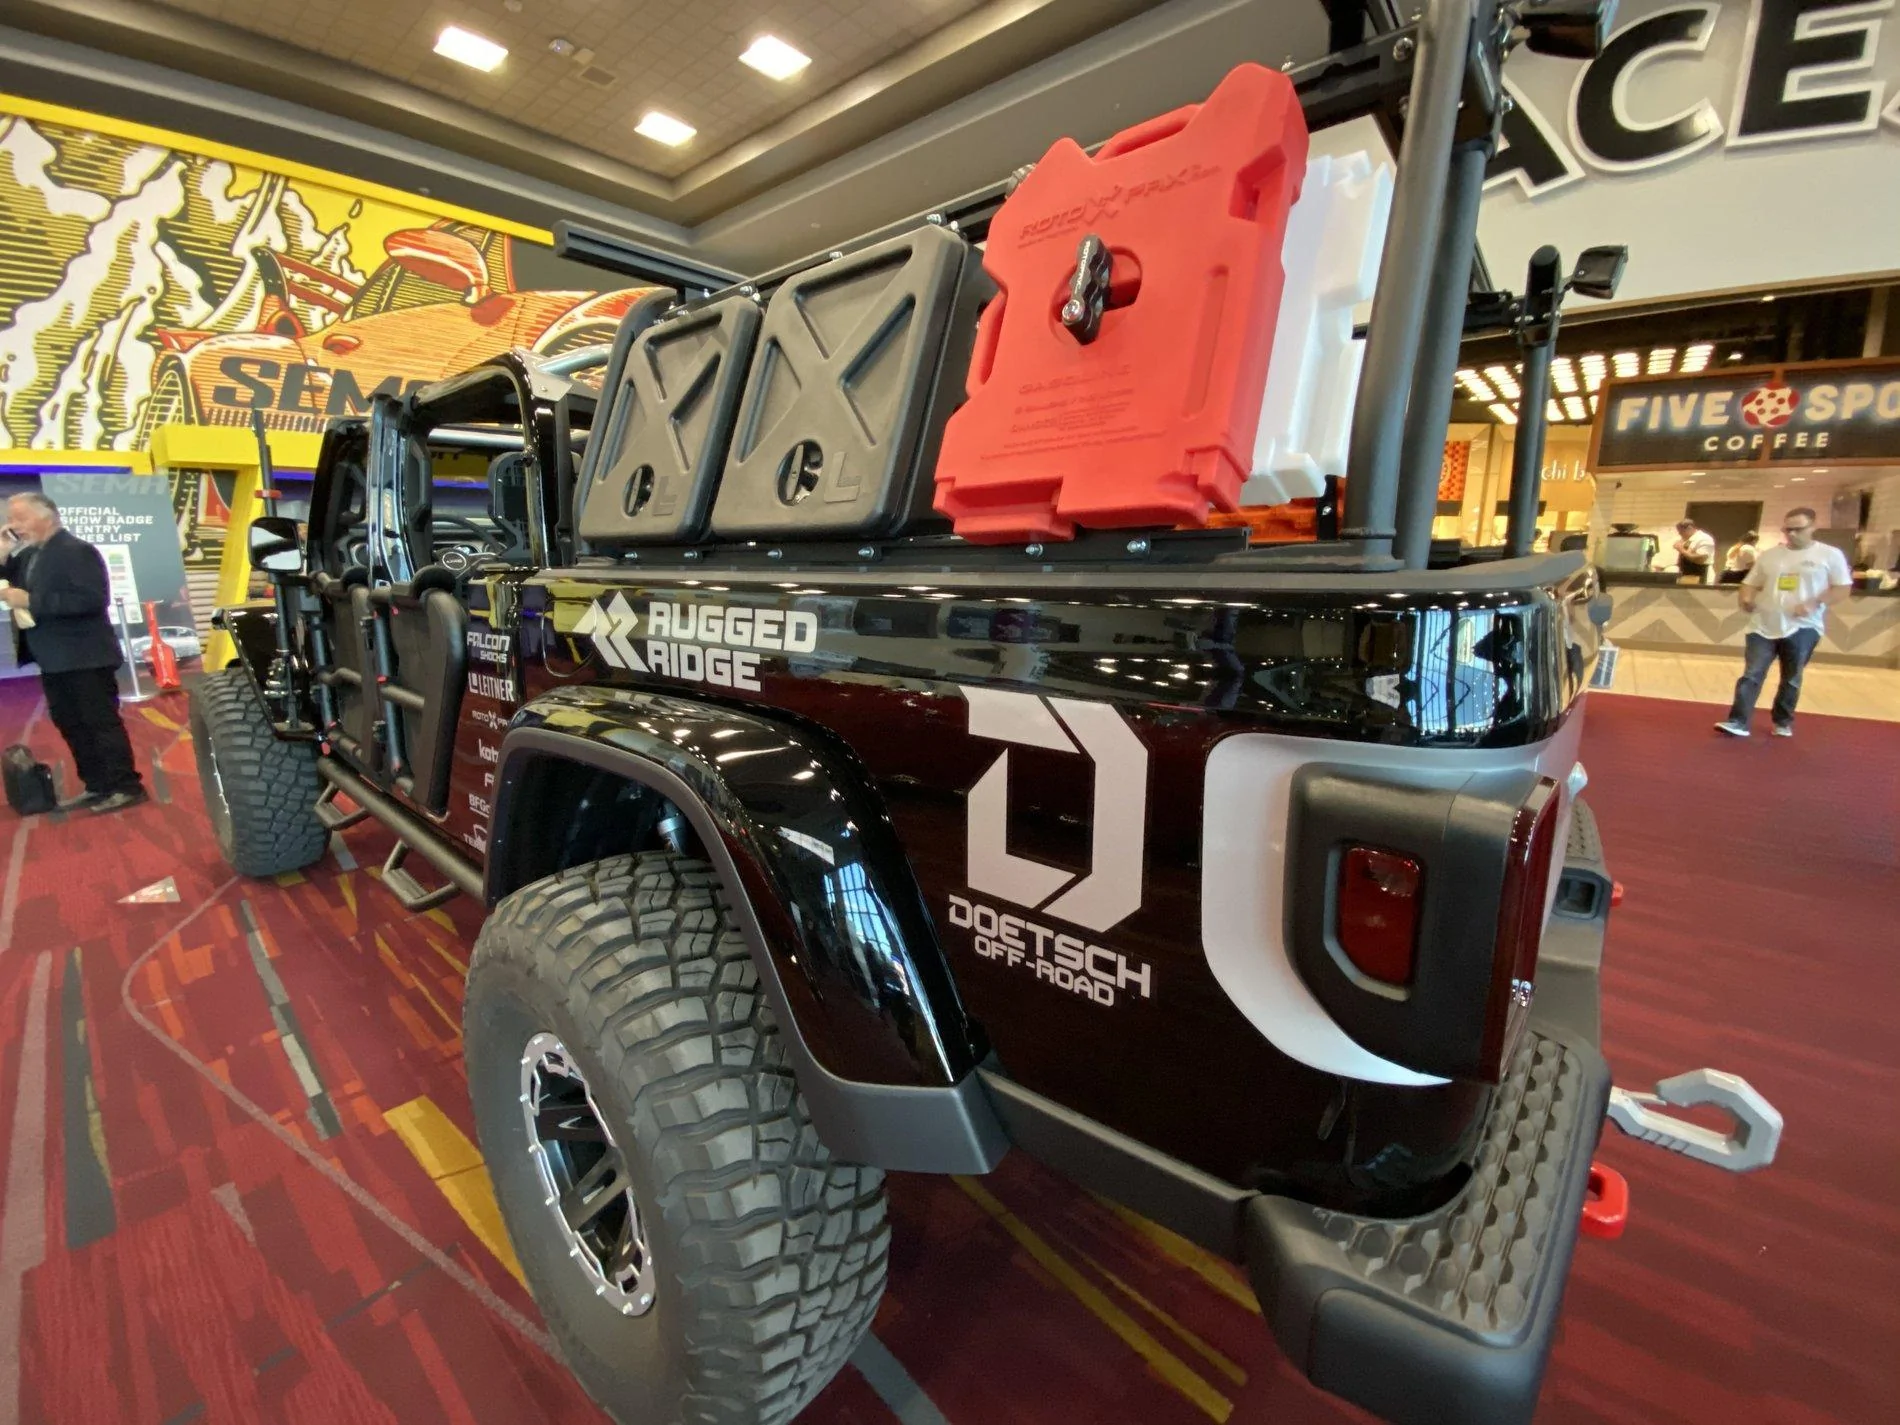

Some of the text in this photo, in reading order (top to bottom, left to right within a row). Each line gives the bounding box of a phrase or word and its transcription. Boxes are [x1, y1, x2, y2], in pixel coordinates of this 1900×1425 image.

[1617, 391, 1733, 431] FIVE
[1704, 432, 1829, 451] COFFEE
[54, 473, 168, 495] SEMA
[58, 507, 120, 516] OFFICIAL
[60, 515, 154, 525] SHOW BADGE
[75, 525, 121, 534] ENTRY
[110, 533, 142, 542] LIST
[648, 601, 818, 653] RUGGED
[467, 631, 511, 652] FALCON
[647, 640, 762, 692] RIDGE
[479, 674, 515, 702] LEITNER
[949, 894, 1151, 999] DOETSCH
[974, 935, 1115, 1007] OFF-ROAD
